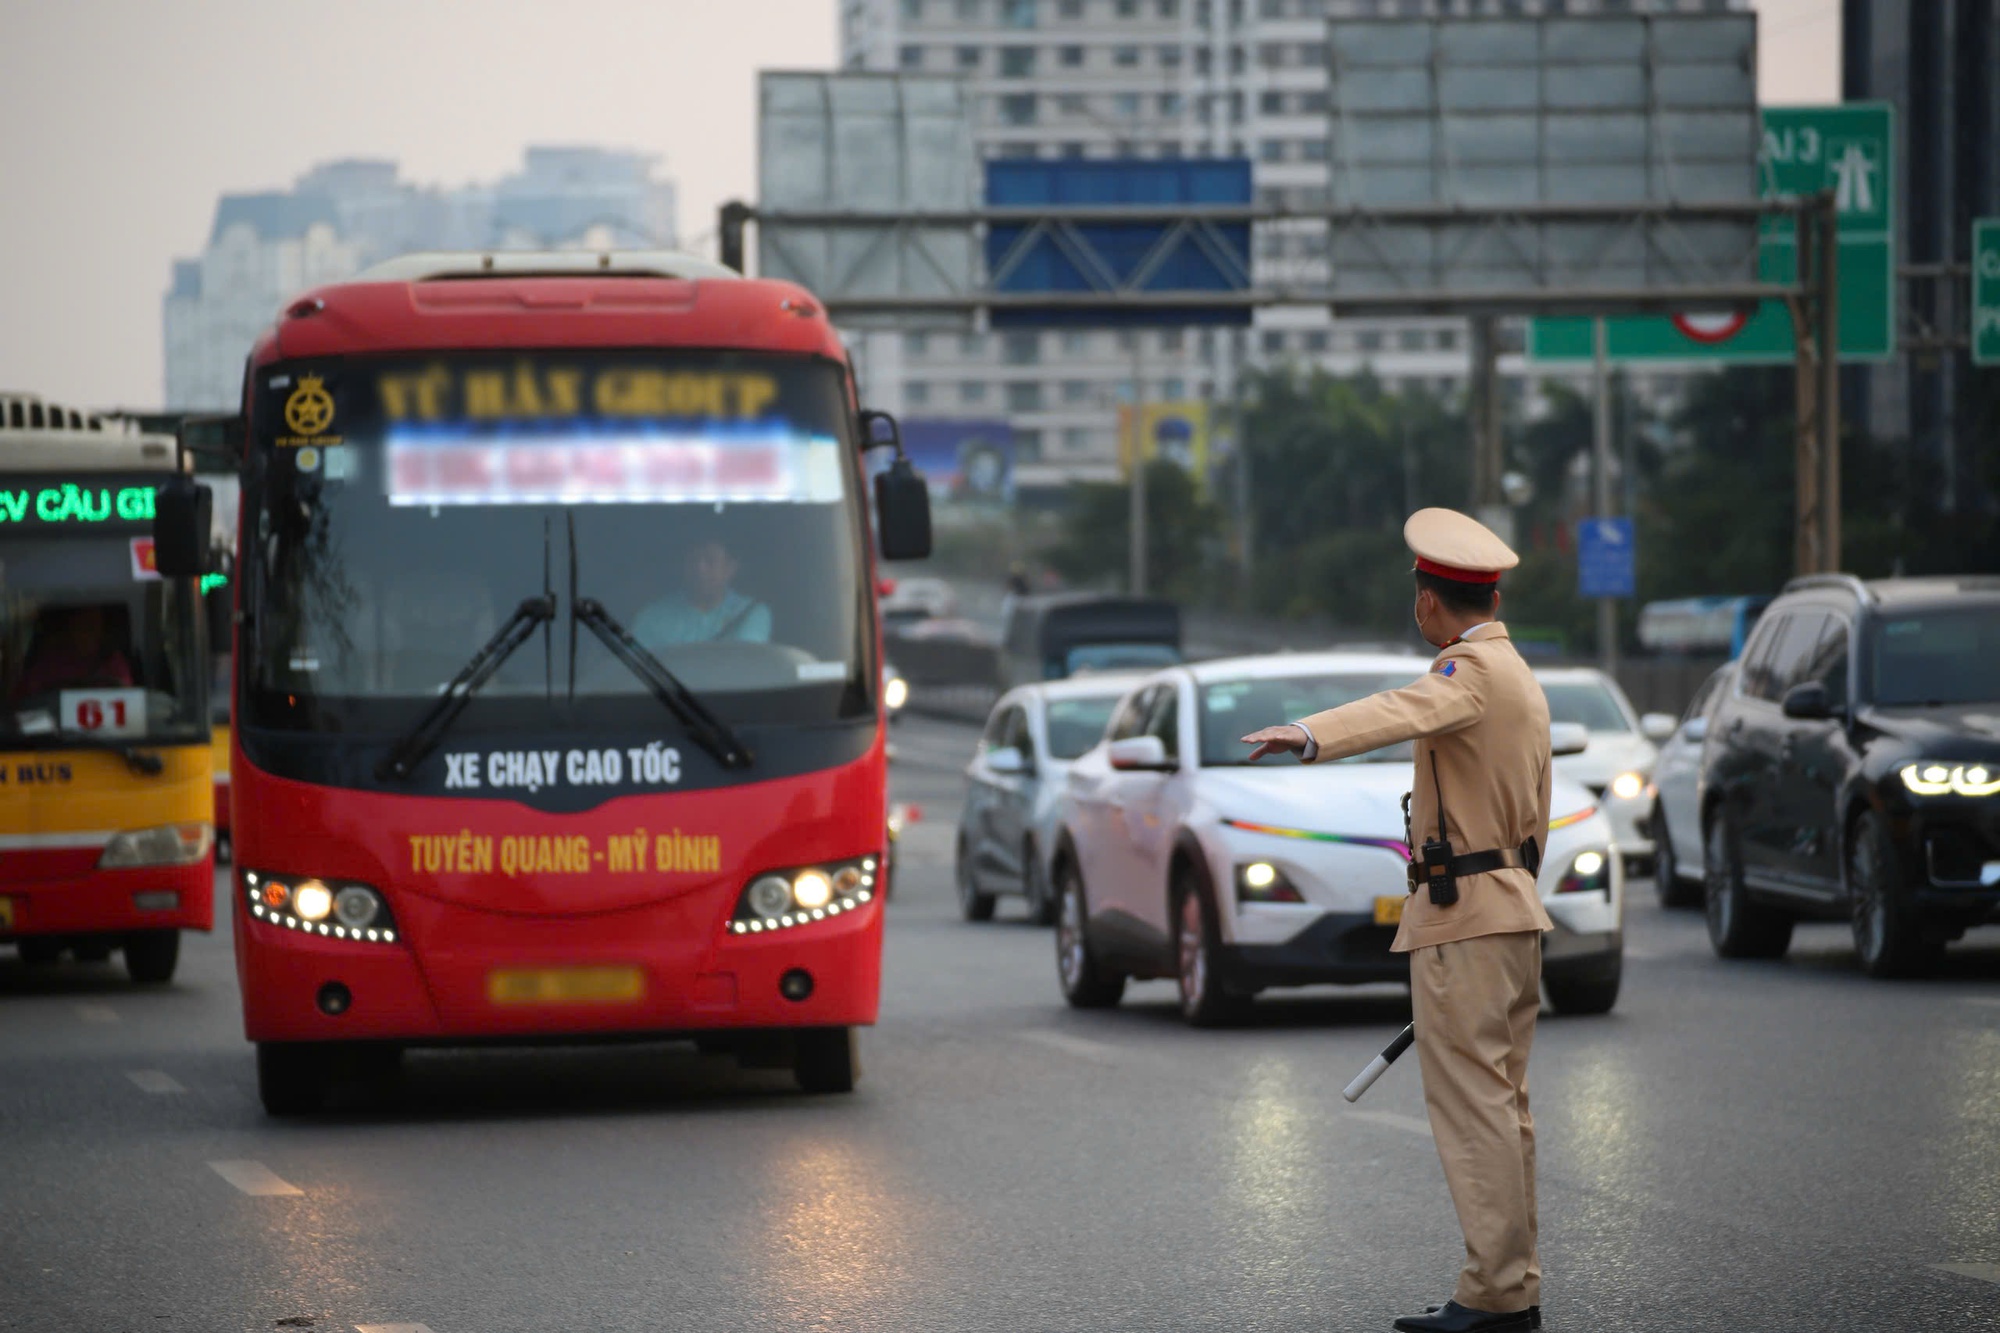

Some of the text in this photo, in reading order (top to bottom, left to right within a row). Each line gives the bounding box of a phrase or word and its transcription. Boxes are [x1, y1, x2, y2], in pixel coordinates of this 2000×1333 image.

[76, 699, 127, 729] 61
[445, 740, 681, 793] XE CHẠY CAO TỐC
[410, 828, 493, 874] TUYÊN
[501, 835, 590, 878] QUANG
[608, 827, 649, 872] MỸ
[655, 827, 720, 873] ĐÌNH
